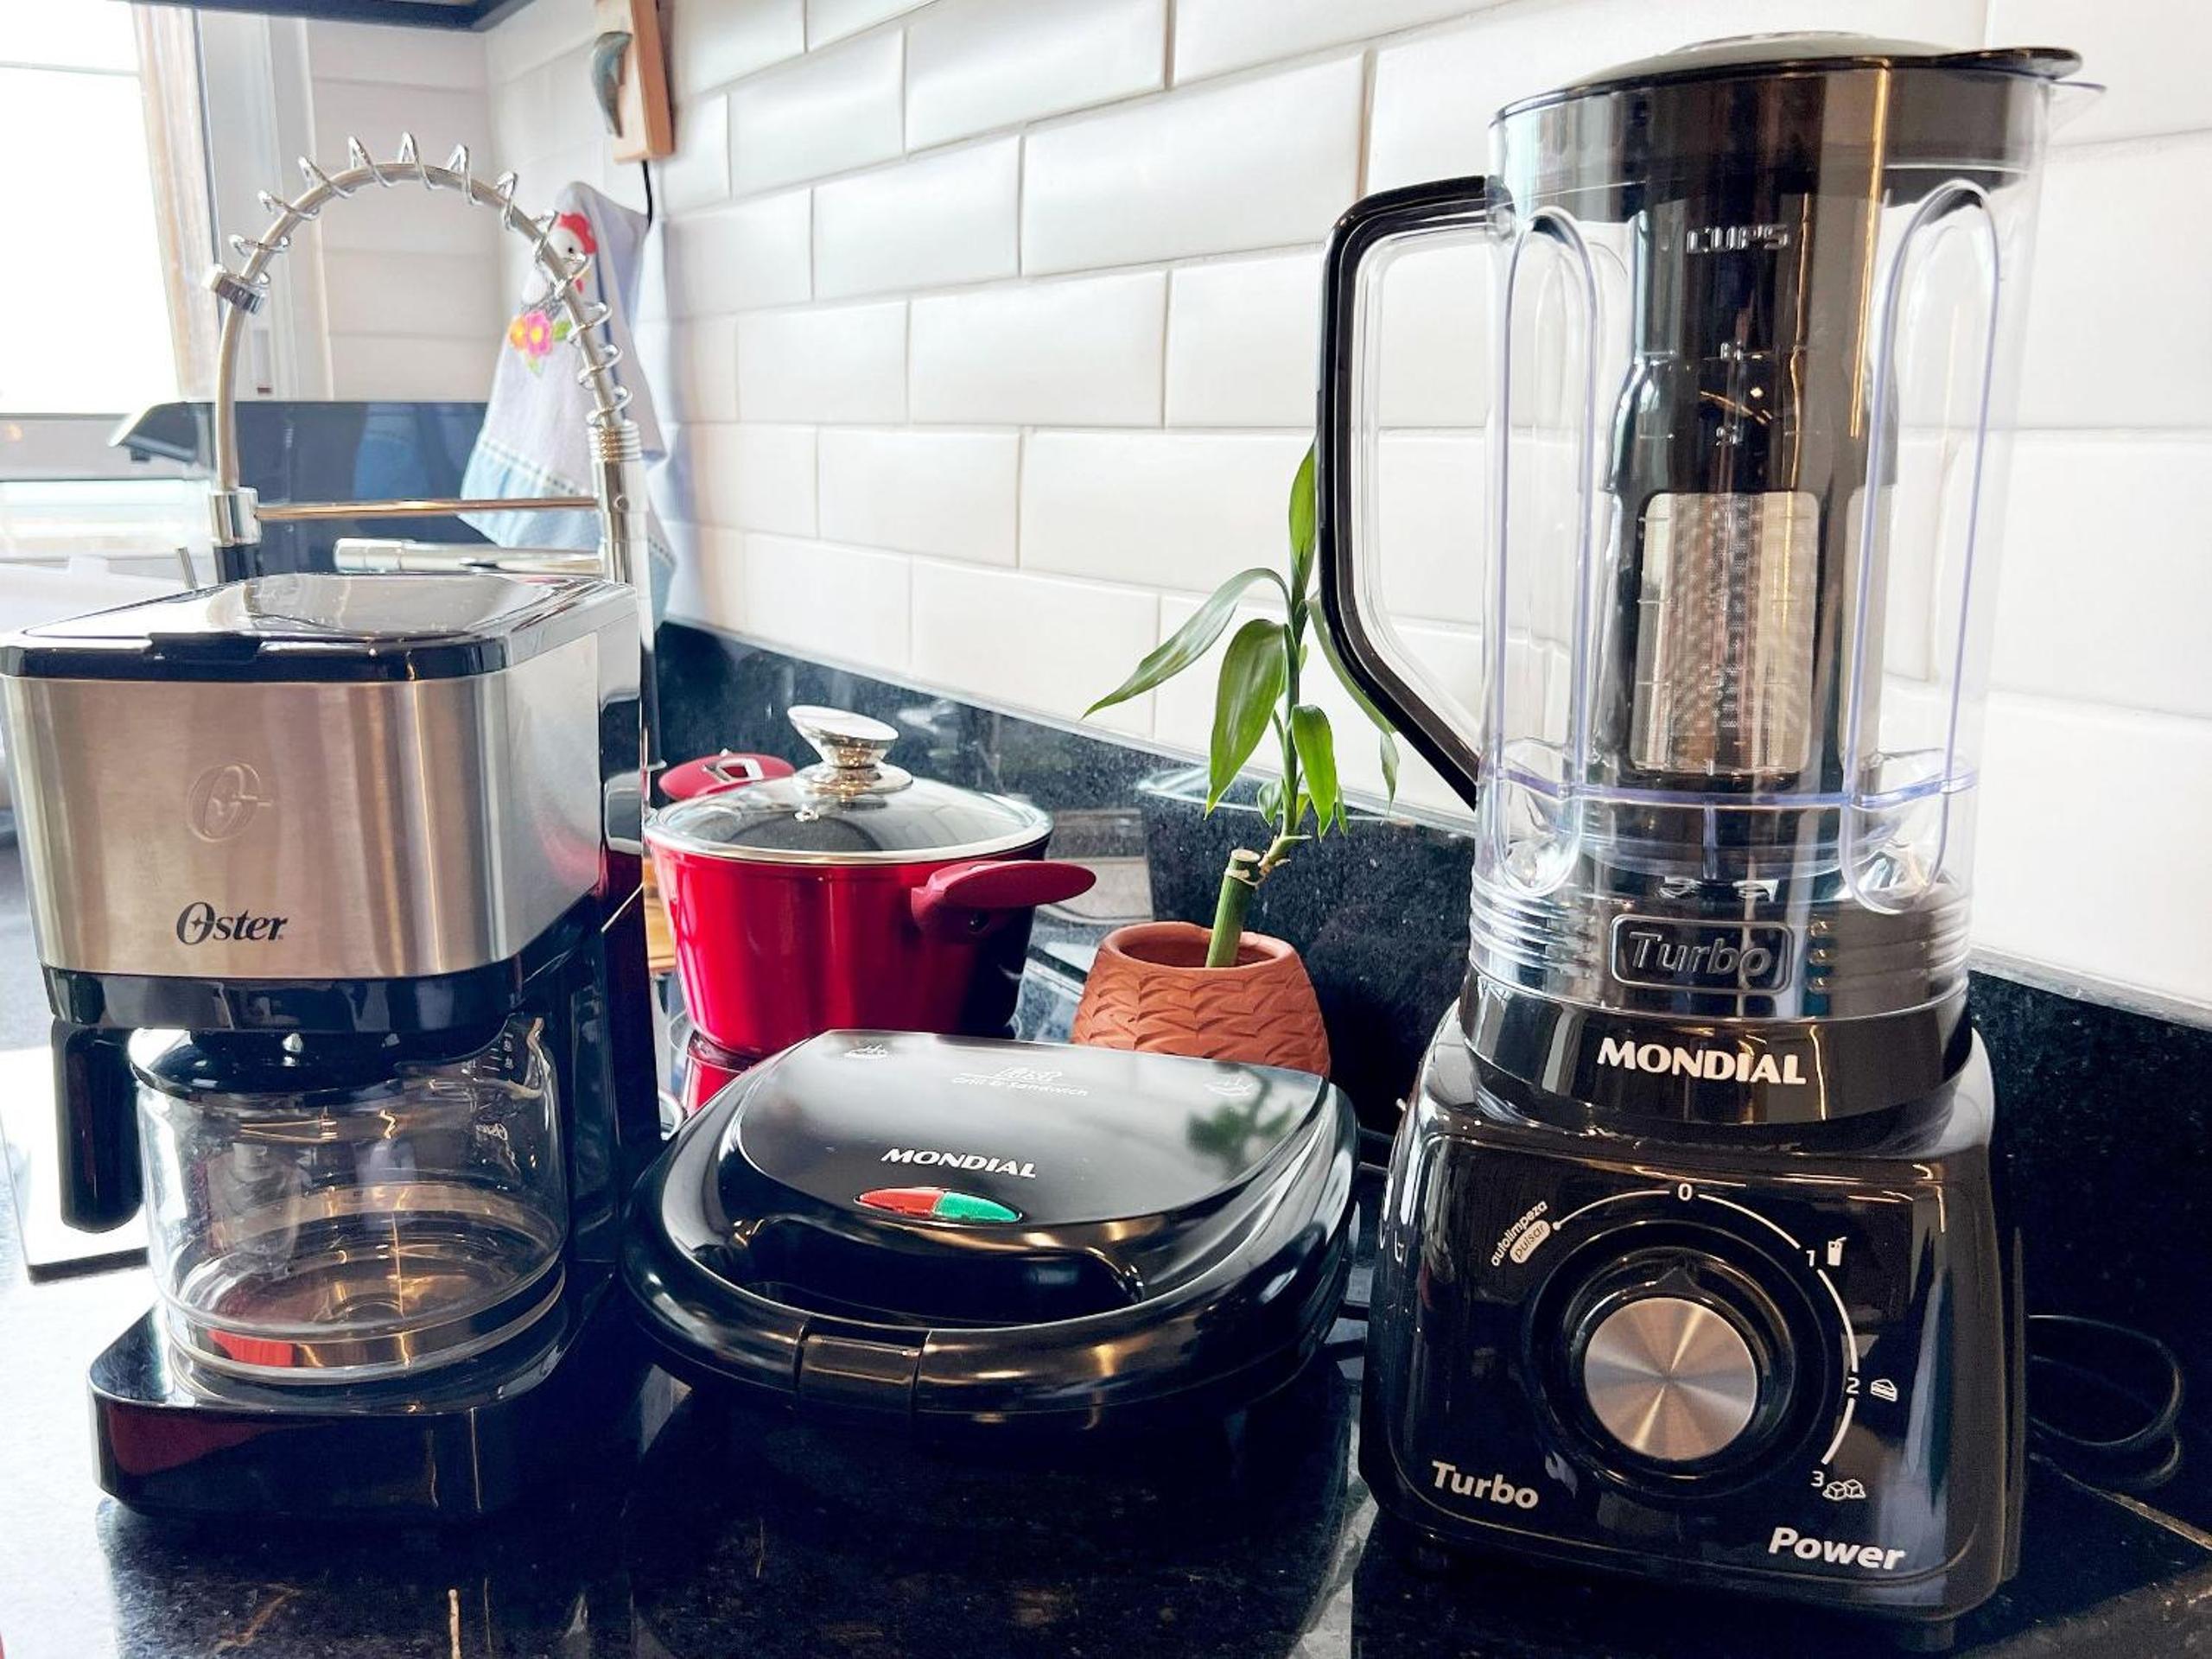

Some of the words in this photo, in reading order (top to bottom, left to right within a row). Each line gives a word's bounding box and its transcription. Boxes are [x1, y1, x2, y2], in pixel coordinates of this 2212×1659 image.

[1687, 224, 1789, 253] CUPS
[175, 901, 289, 945] Oster
[1629, 931, 1771, 977] Turbo
[1597, 1037, 1807, 1085] MONDIAL
[881, 1147, 1037, 1179] MONDIAL
[1677, 1183, 1694, 1202] 0
[1491, 1200, 1548, 1267] autolimpeza
[1514, 1223, 1546, 1260] pulsar
[1806, 1249, 1815, 1267] 1
[1846, 1377, 1860, 1395] 2
[1432, 1459, 1539, 1509] Turbo
[1810, 1471, 1825, 1487] 3
[1768, 1527, 1907, 1570] Power
